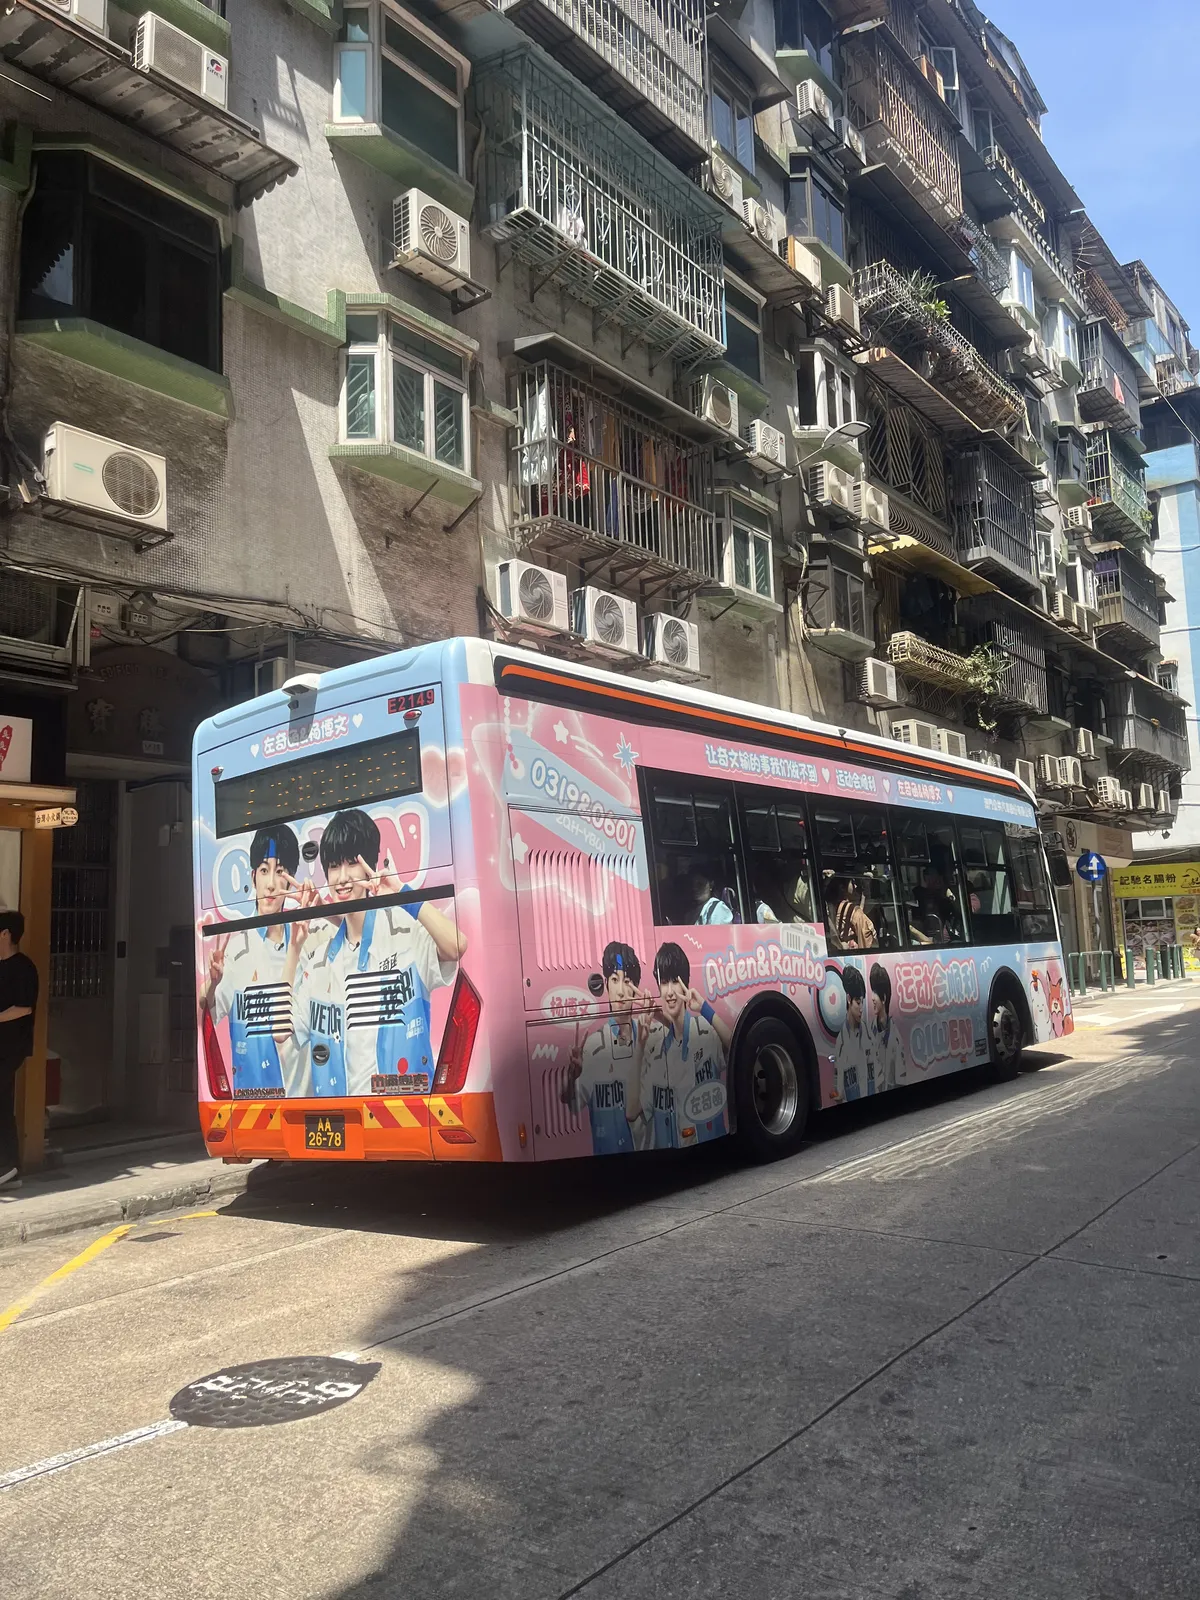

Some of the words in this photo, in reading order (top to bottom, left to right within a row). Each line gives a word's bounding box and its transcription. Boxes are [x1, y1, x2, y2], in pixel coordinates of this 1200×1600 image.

[388, 690, 434, 713] E2149
[705, 944, 825, 996] Aiden&Rambo
[911, 1017, 973, 1067] QIWEN
[317, 1118, 332, 1132] AA
[308, 1132, 342, 1147] 26-78
